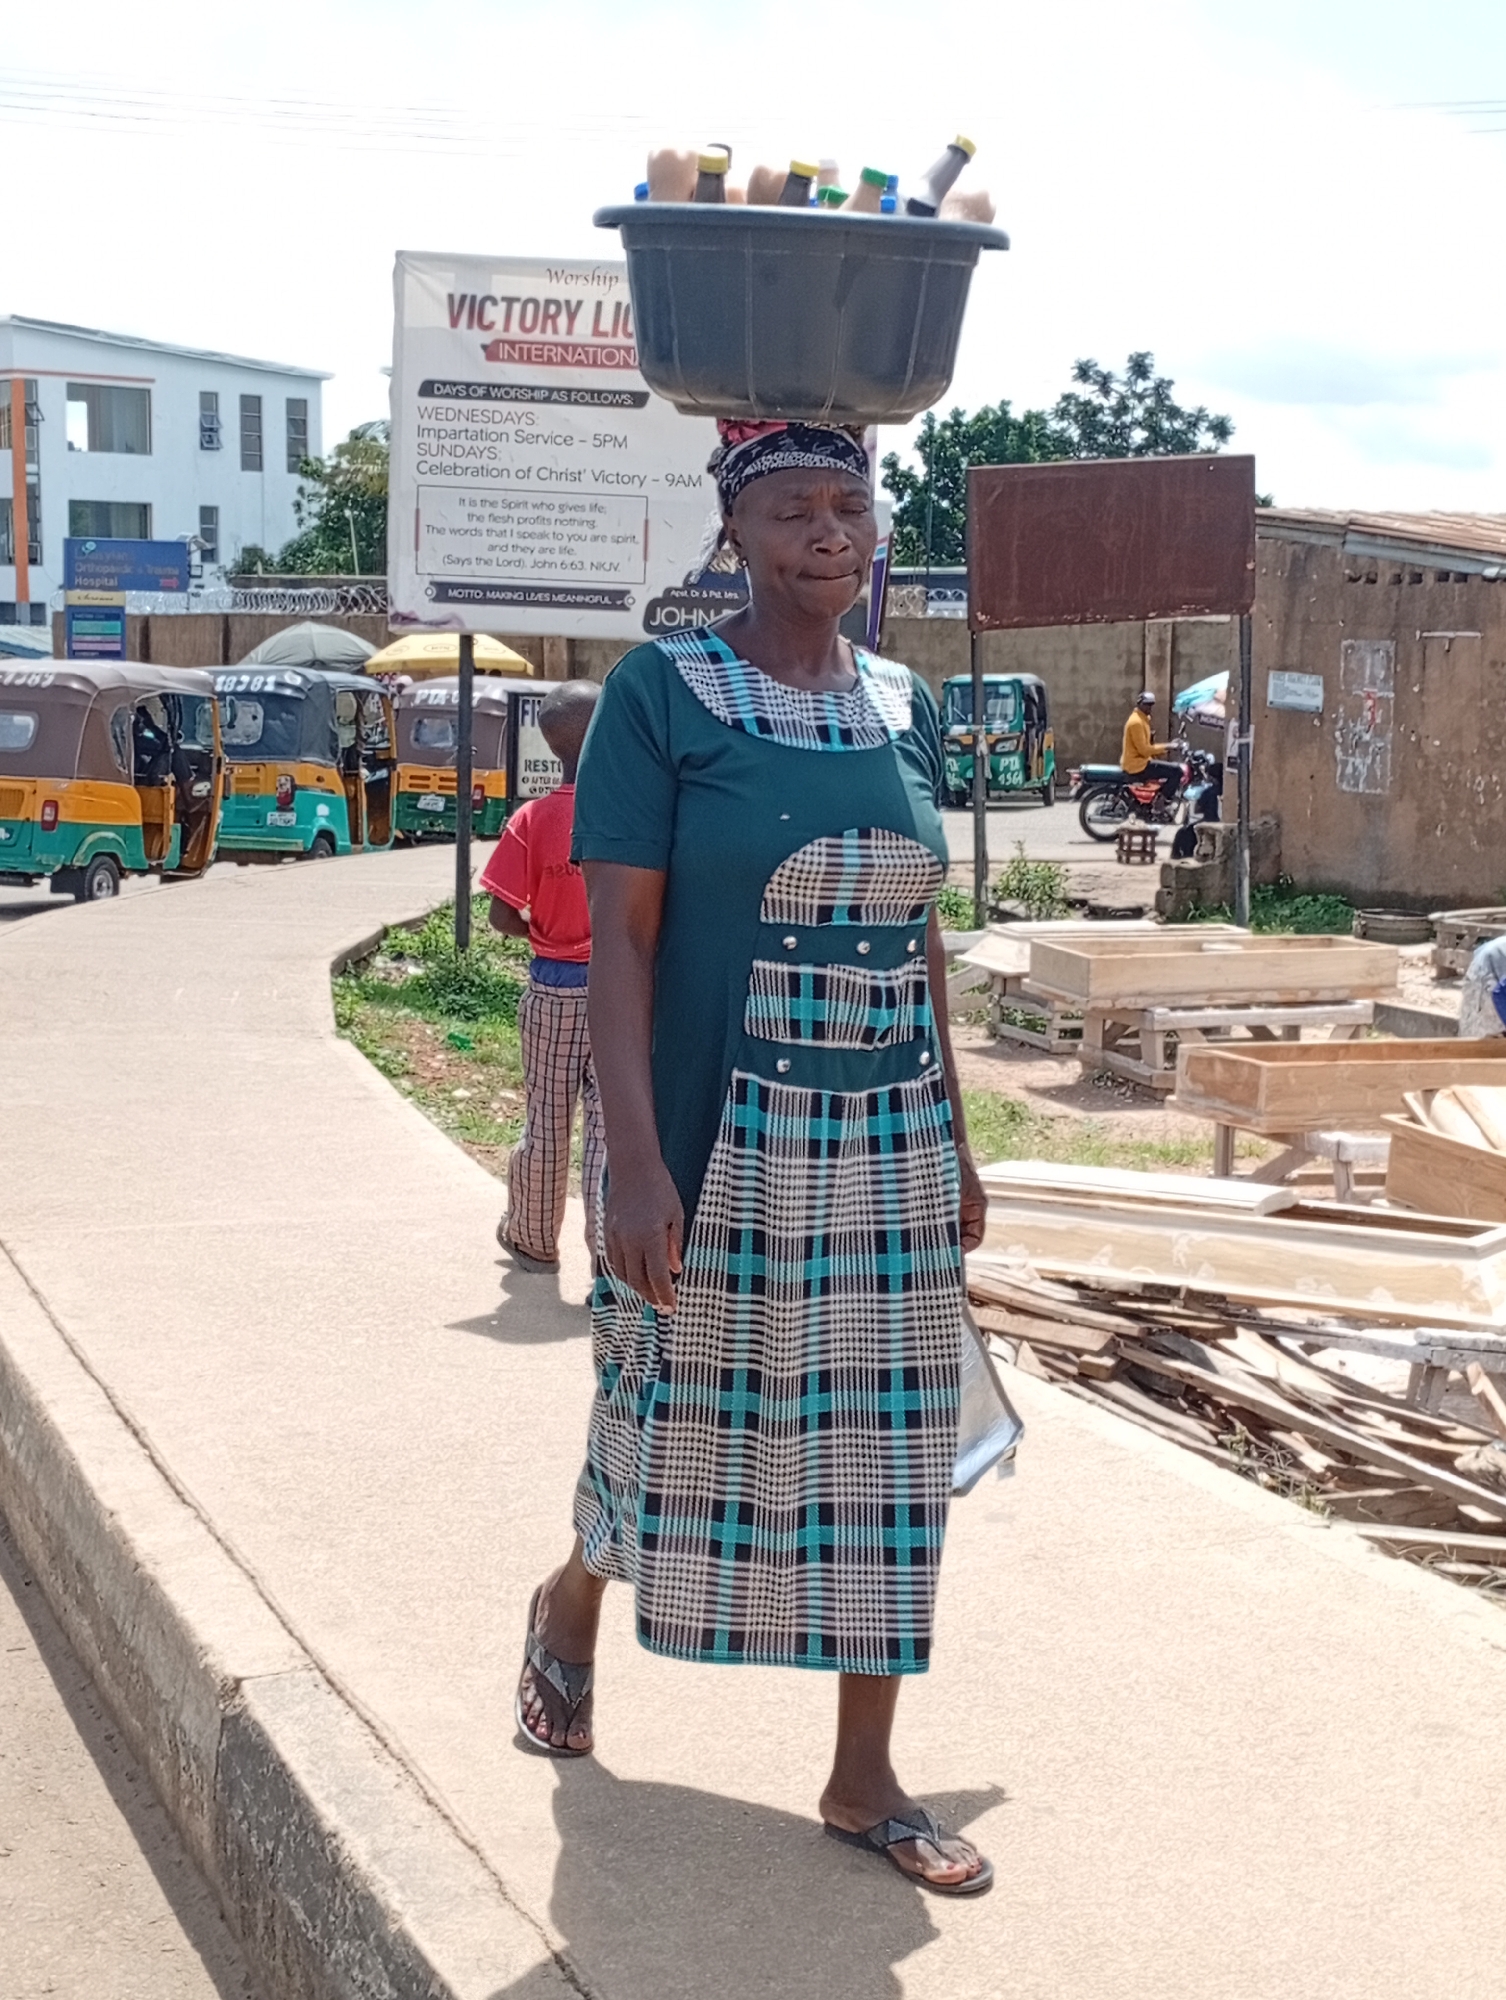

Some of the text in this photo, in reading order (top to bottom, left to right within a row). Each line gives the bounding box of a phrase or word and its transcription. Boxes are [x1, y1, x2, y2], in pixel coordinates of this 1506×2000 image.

[547, 266, 619, 295] Worship
[447, 293, 584, 336] VICTORY
[433, 384, 467, 397] DAYS
[469, 386, 487, 398] OF
[489, 387, 549, 401] WORSHIP
[551, 390, 569, 402] AS
[417, 425, 510, 443] Impartation
[514, 429, 574, 447] Service
[592, 433, 628, 450] 5PM
[416, 460, 511, 479] Celebration
[515, 466, 533, 480] of
[591, 469, 648, 489] Victory
[665, 473, 702, 488] 9AM
[459, 497, 466, 507] It
[469, 497, 477, 508] is
[480, 498, 498, 509] the
[501, 499, 528, 511] Spirit
[532, 501, 555, 511] who
[558, 502, 586, 514] gives
[467, 512, 485, 523] the
[489, 513, 514, 524] flesh
[517, 514, 552, 526] profits
[426, 524, 446, 535] The
[449, 527, 483, 537] words
[486, 528, 507, 538] that
[510, 528, 514, 538] I
[517, 530, 550, 541] speak
[552, 531, 564, 541] to
[567, 533, 587, 543] you
[590, 534, 608, 544] are
[487, 543, 509, 553] and
[511, 544, 535, 555] they
[538, 546, 556, 555] are
[442, 554, 473, 568] (Says
[475, 556, 494, 567] the
[530, 559, 557, 569] John
[75, 576, 118, 588] Hospital
[486, 590, 524, 601] MAKING
[649, 607, 715, 627] JOHN
